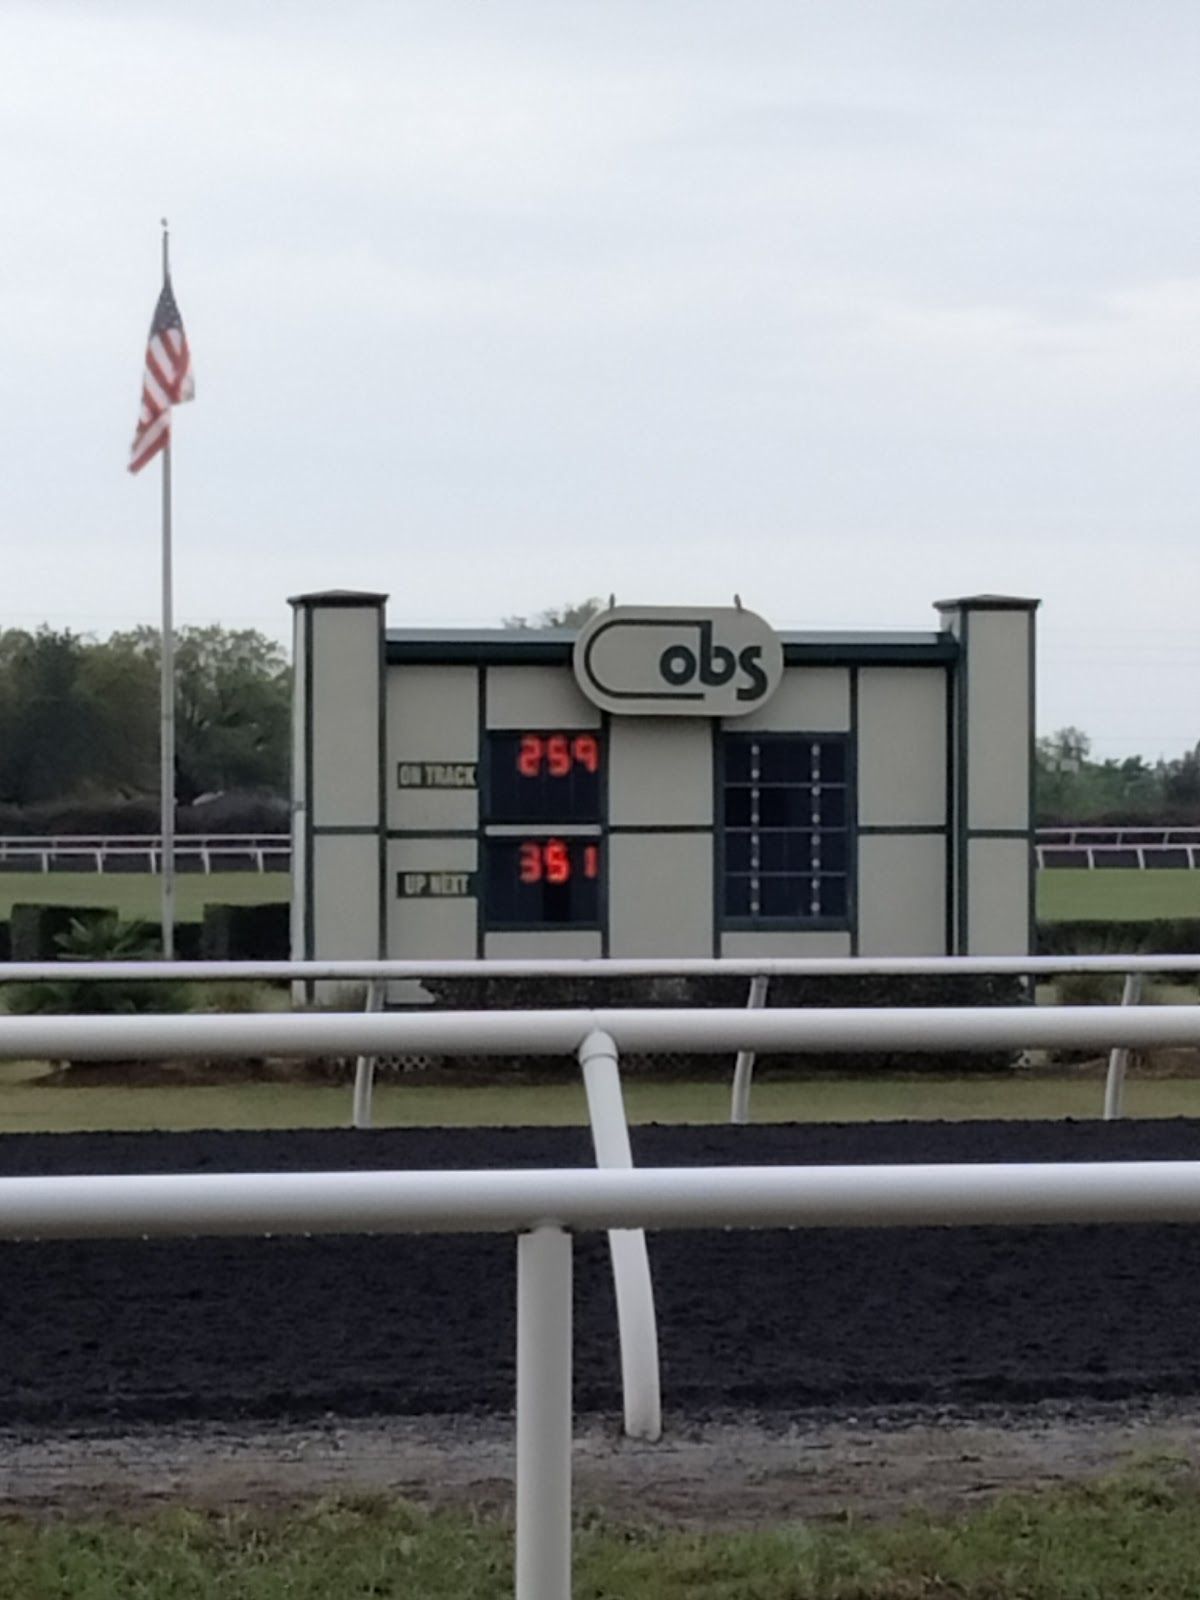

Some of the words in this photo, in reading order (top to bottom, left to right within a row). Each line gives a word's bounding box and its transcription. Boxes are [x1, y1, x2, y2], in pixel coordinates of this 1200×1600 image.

[659, 619, 768, 701] obs
[400, 765, 421, 786] ON
[425, 765, 477, 786] TRACK
[518, 735, 598, 777] 259
[520, 840, 598, 883] 351
[404, 874, 426, 895] UP
[429, 874, 469, 895] NEXT
